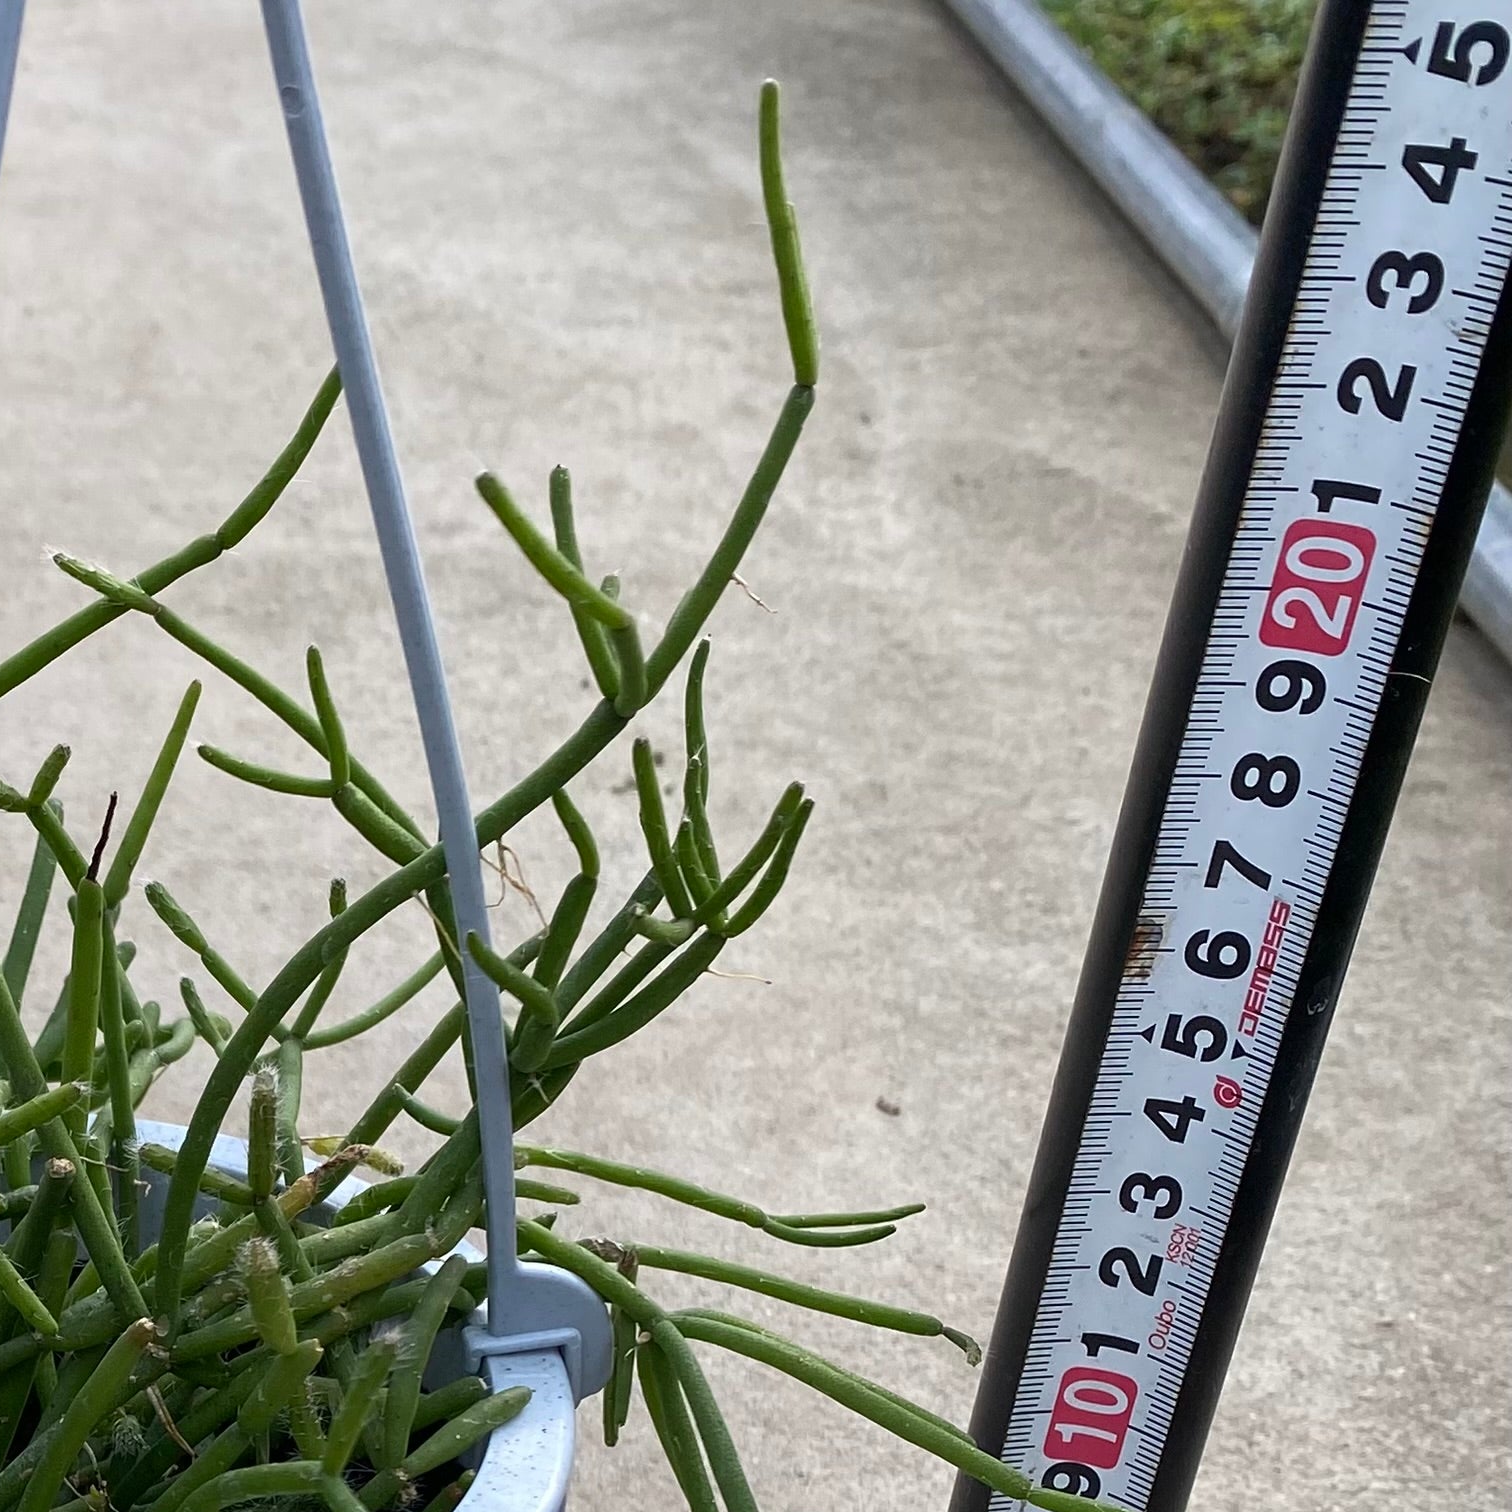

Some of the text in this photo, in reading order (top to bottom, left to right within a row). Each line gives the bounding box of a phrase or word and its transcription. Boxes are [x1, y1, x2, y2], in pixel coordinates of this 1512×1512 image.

[1426, 20, 1510, 87] 5
[1401, 137, 1479, 205] 4
[1366, 250, 1445, 315] 3
[1336, 357, 1418, 423] 2
[1310, 479, 1383, 513] 1
[1271, 536, 1365, 640] 20
[1255, 659, 1327, 715] 9
[1230, 752, 1301, 808] 8
[1204, 840, 1272, 892] 7
[1184, 929, 1252, 980] 6
[1160, 1013, 1228, 1063] 5
[1143, 1095, 1207, 1144] 4
[1118, 1172, 1183, 1220] 3
[1098, 1246, 1164, 1297] 2
[1080, 1332, 1141, 1358] 1
[1054, 1379, 1129, 1444] 10
[1040, 1461, 1101, 1501] 9
